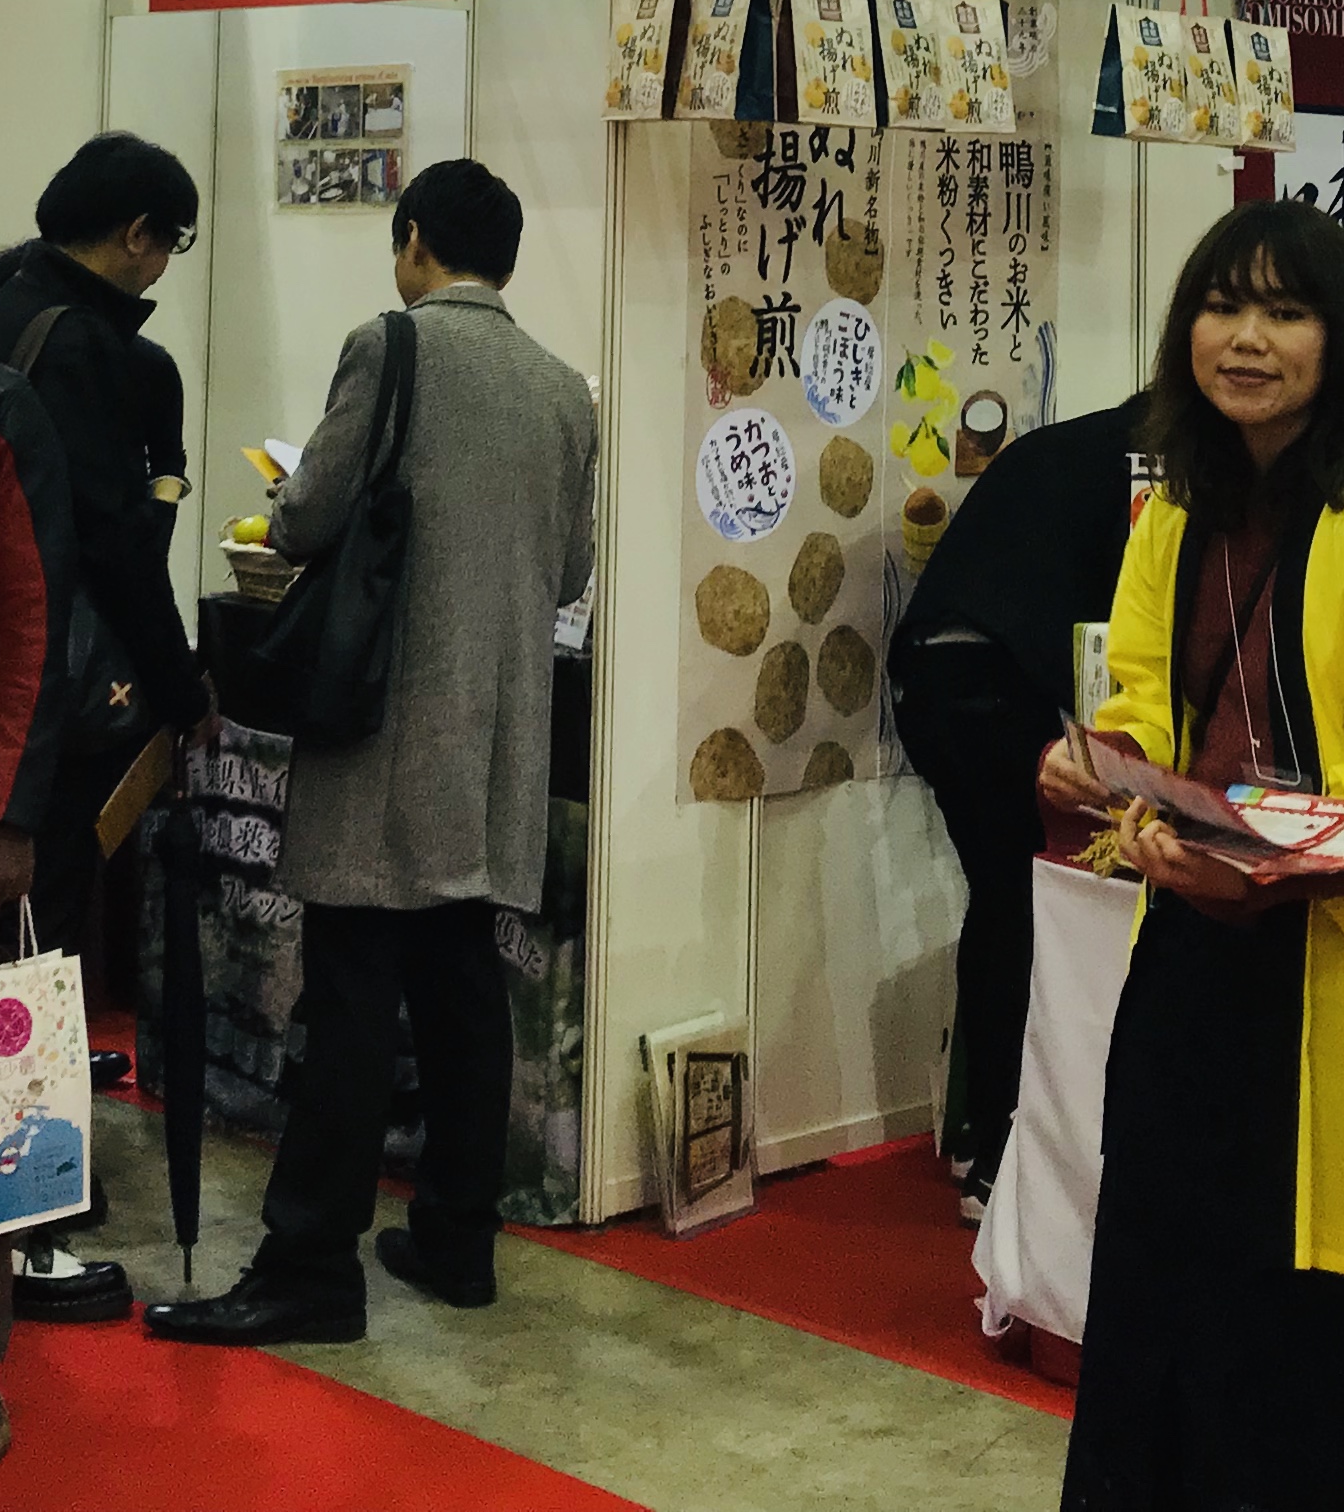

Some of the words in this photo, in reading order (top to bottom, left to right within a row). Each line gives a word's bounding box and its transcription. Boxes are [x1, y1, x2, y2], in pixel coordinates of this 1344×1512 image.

[808, 127, 856, 248] ぬれ
[863, 126, 885, 257] 川新名物】
[966, 138, 992, 366] 和素材にこだわった
[998, 139, 1035, 363] 鴨川のお米と
[748, 128, 807, 380] 揚げ煎
[849, 317, 871, 410] ひじきと
[725, 425, 757, 491] うめ味
